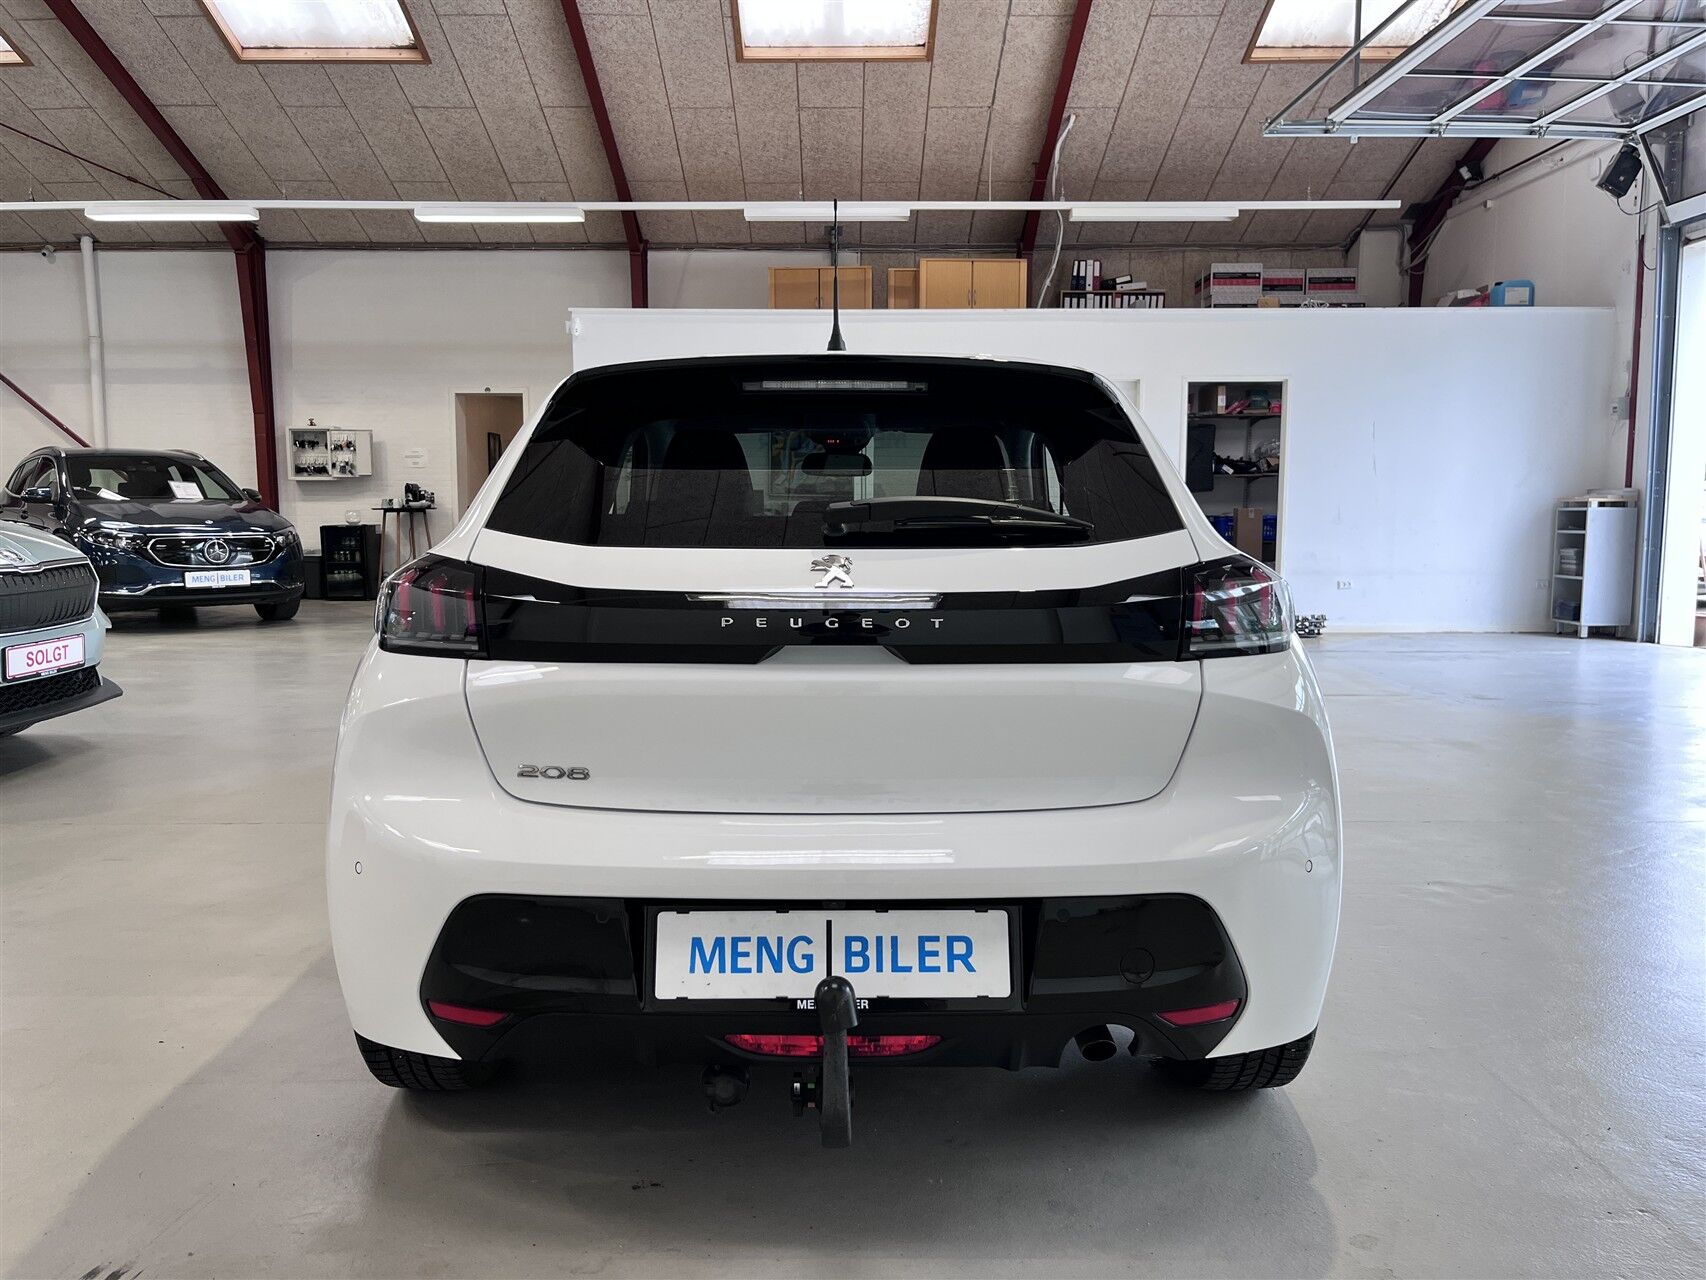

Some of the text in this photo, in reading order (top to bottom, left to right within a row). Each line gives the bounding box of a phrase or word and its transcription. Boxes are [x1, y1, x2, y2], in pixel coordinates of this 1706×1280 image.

[192, 574, 244, 583] MENG BILER
[721, 617, 944, 629] PEUGEOT
[26, 645, 69, 667] SOLGT
[517, 764, 591, 780] 208
[688, 935, 977, 974] MENG BILER
